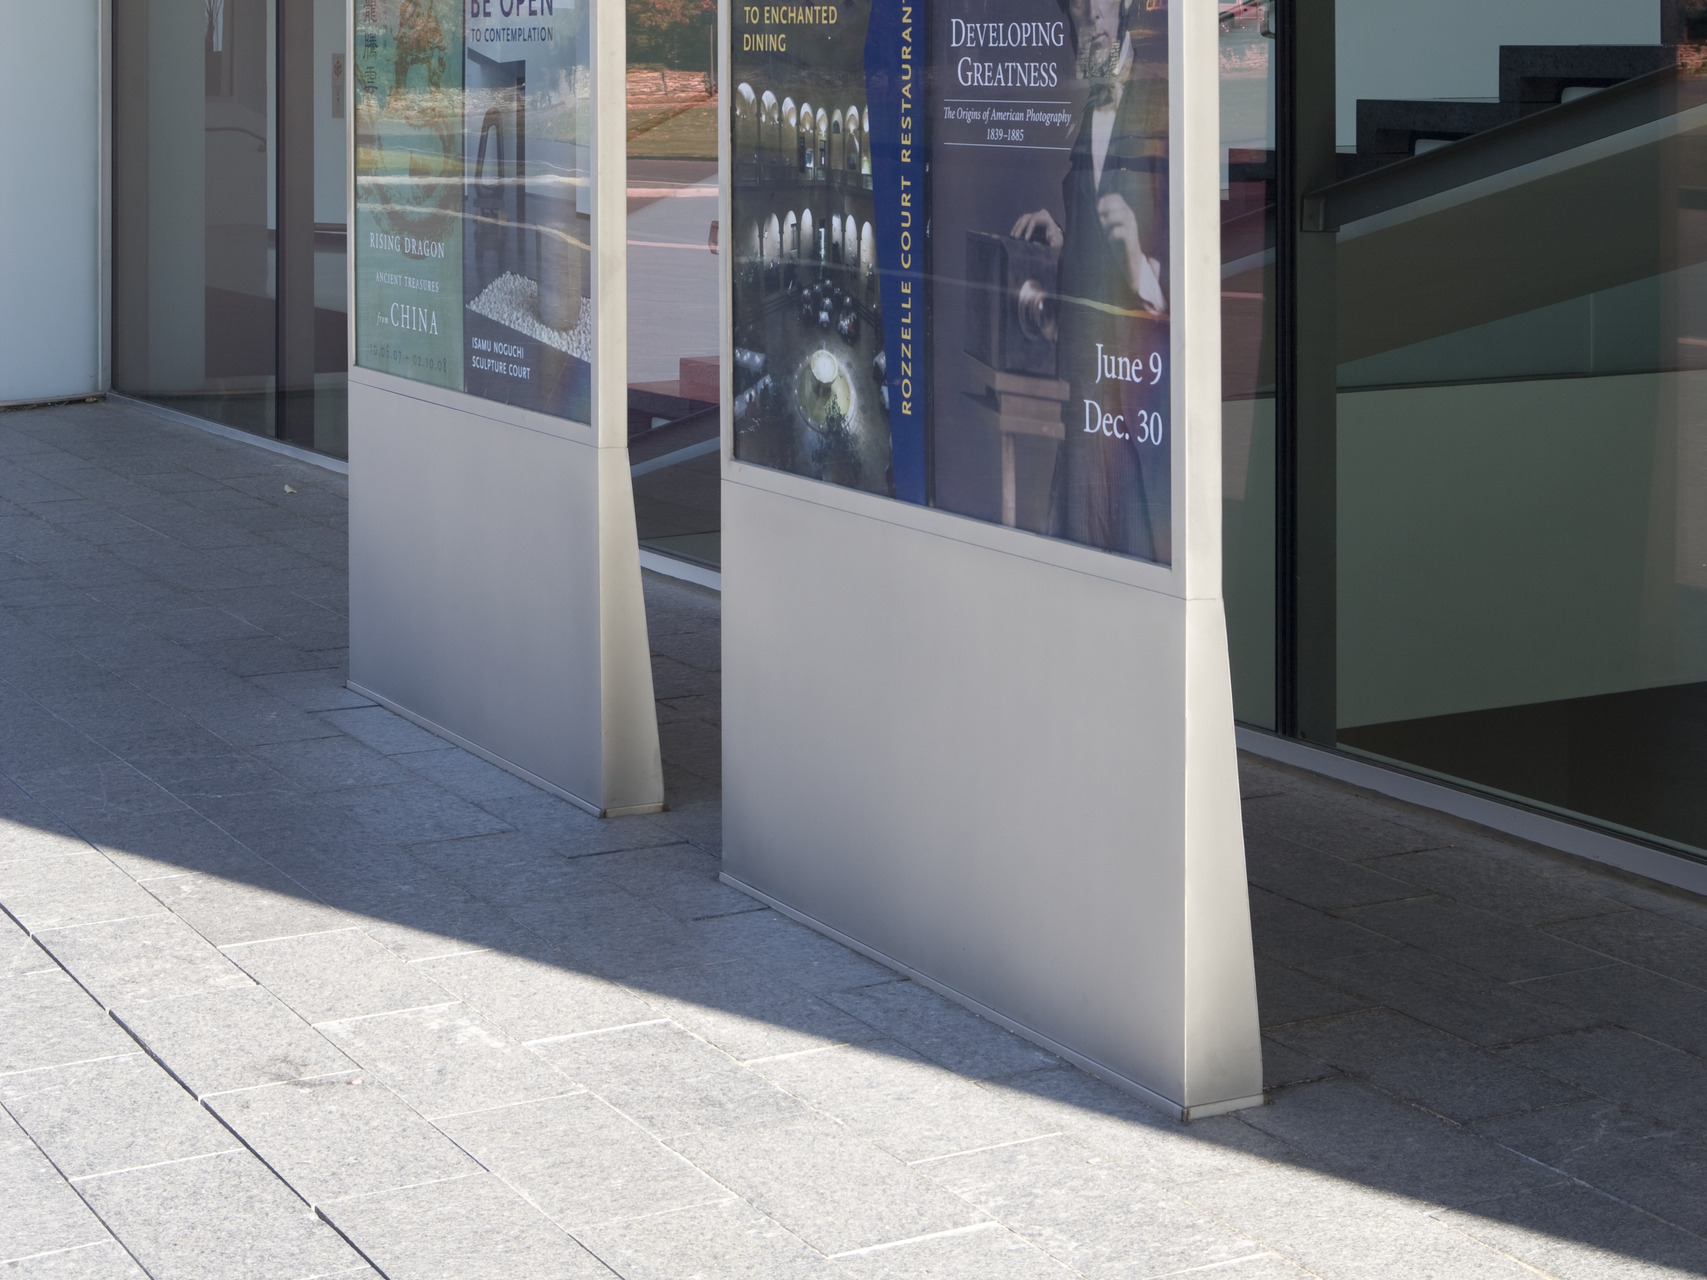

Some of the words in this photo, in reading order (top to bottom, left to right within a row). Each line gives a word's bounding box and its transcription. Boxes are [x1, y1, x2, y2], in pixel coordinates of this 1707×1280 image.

[744, 6, 760, 24] TO
[764, 6, 838, 24] ENCHANTED
[471, 28, 482, 43] TO
[484, 26, 554, 42] CONTEMPLATION
[743, 34, 786, 52] DINING
[944, 106, 955, 119] The
[956, 107, 982, 123] Origins
[982, 107, 991, 124] of
[990, 108, 1024, 121] American
[1025, 108, 1072, 126] Photography
[901, 176, 911, 269] COURT
[369, 232, 401, 252] RISING
[404, 237, 445, 259] DRAGON
[376, 271, 403, 287] ANCIENT
[404, 276, 440, 293] TREASURES
[376, 311, 389, 326] from
[390, 302, 439, 336] CHINA
[472, 337, 492, 352] ISAMU
[494, 341, 525, 359] NOGUCHI
[901, 281, 912, 416] ROZZELLE
[472, 355, 507, 375] SCULPTURE
[508, 363, 531, 380] COURT
[1095, 343, 1143, 384] June
[1149, 352, 1162, 385] 9
[1083, 399, 1130, 440] Dec.
[1137, 409, 1163, 445] 30
